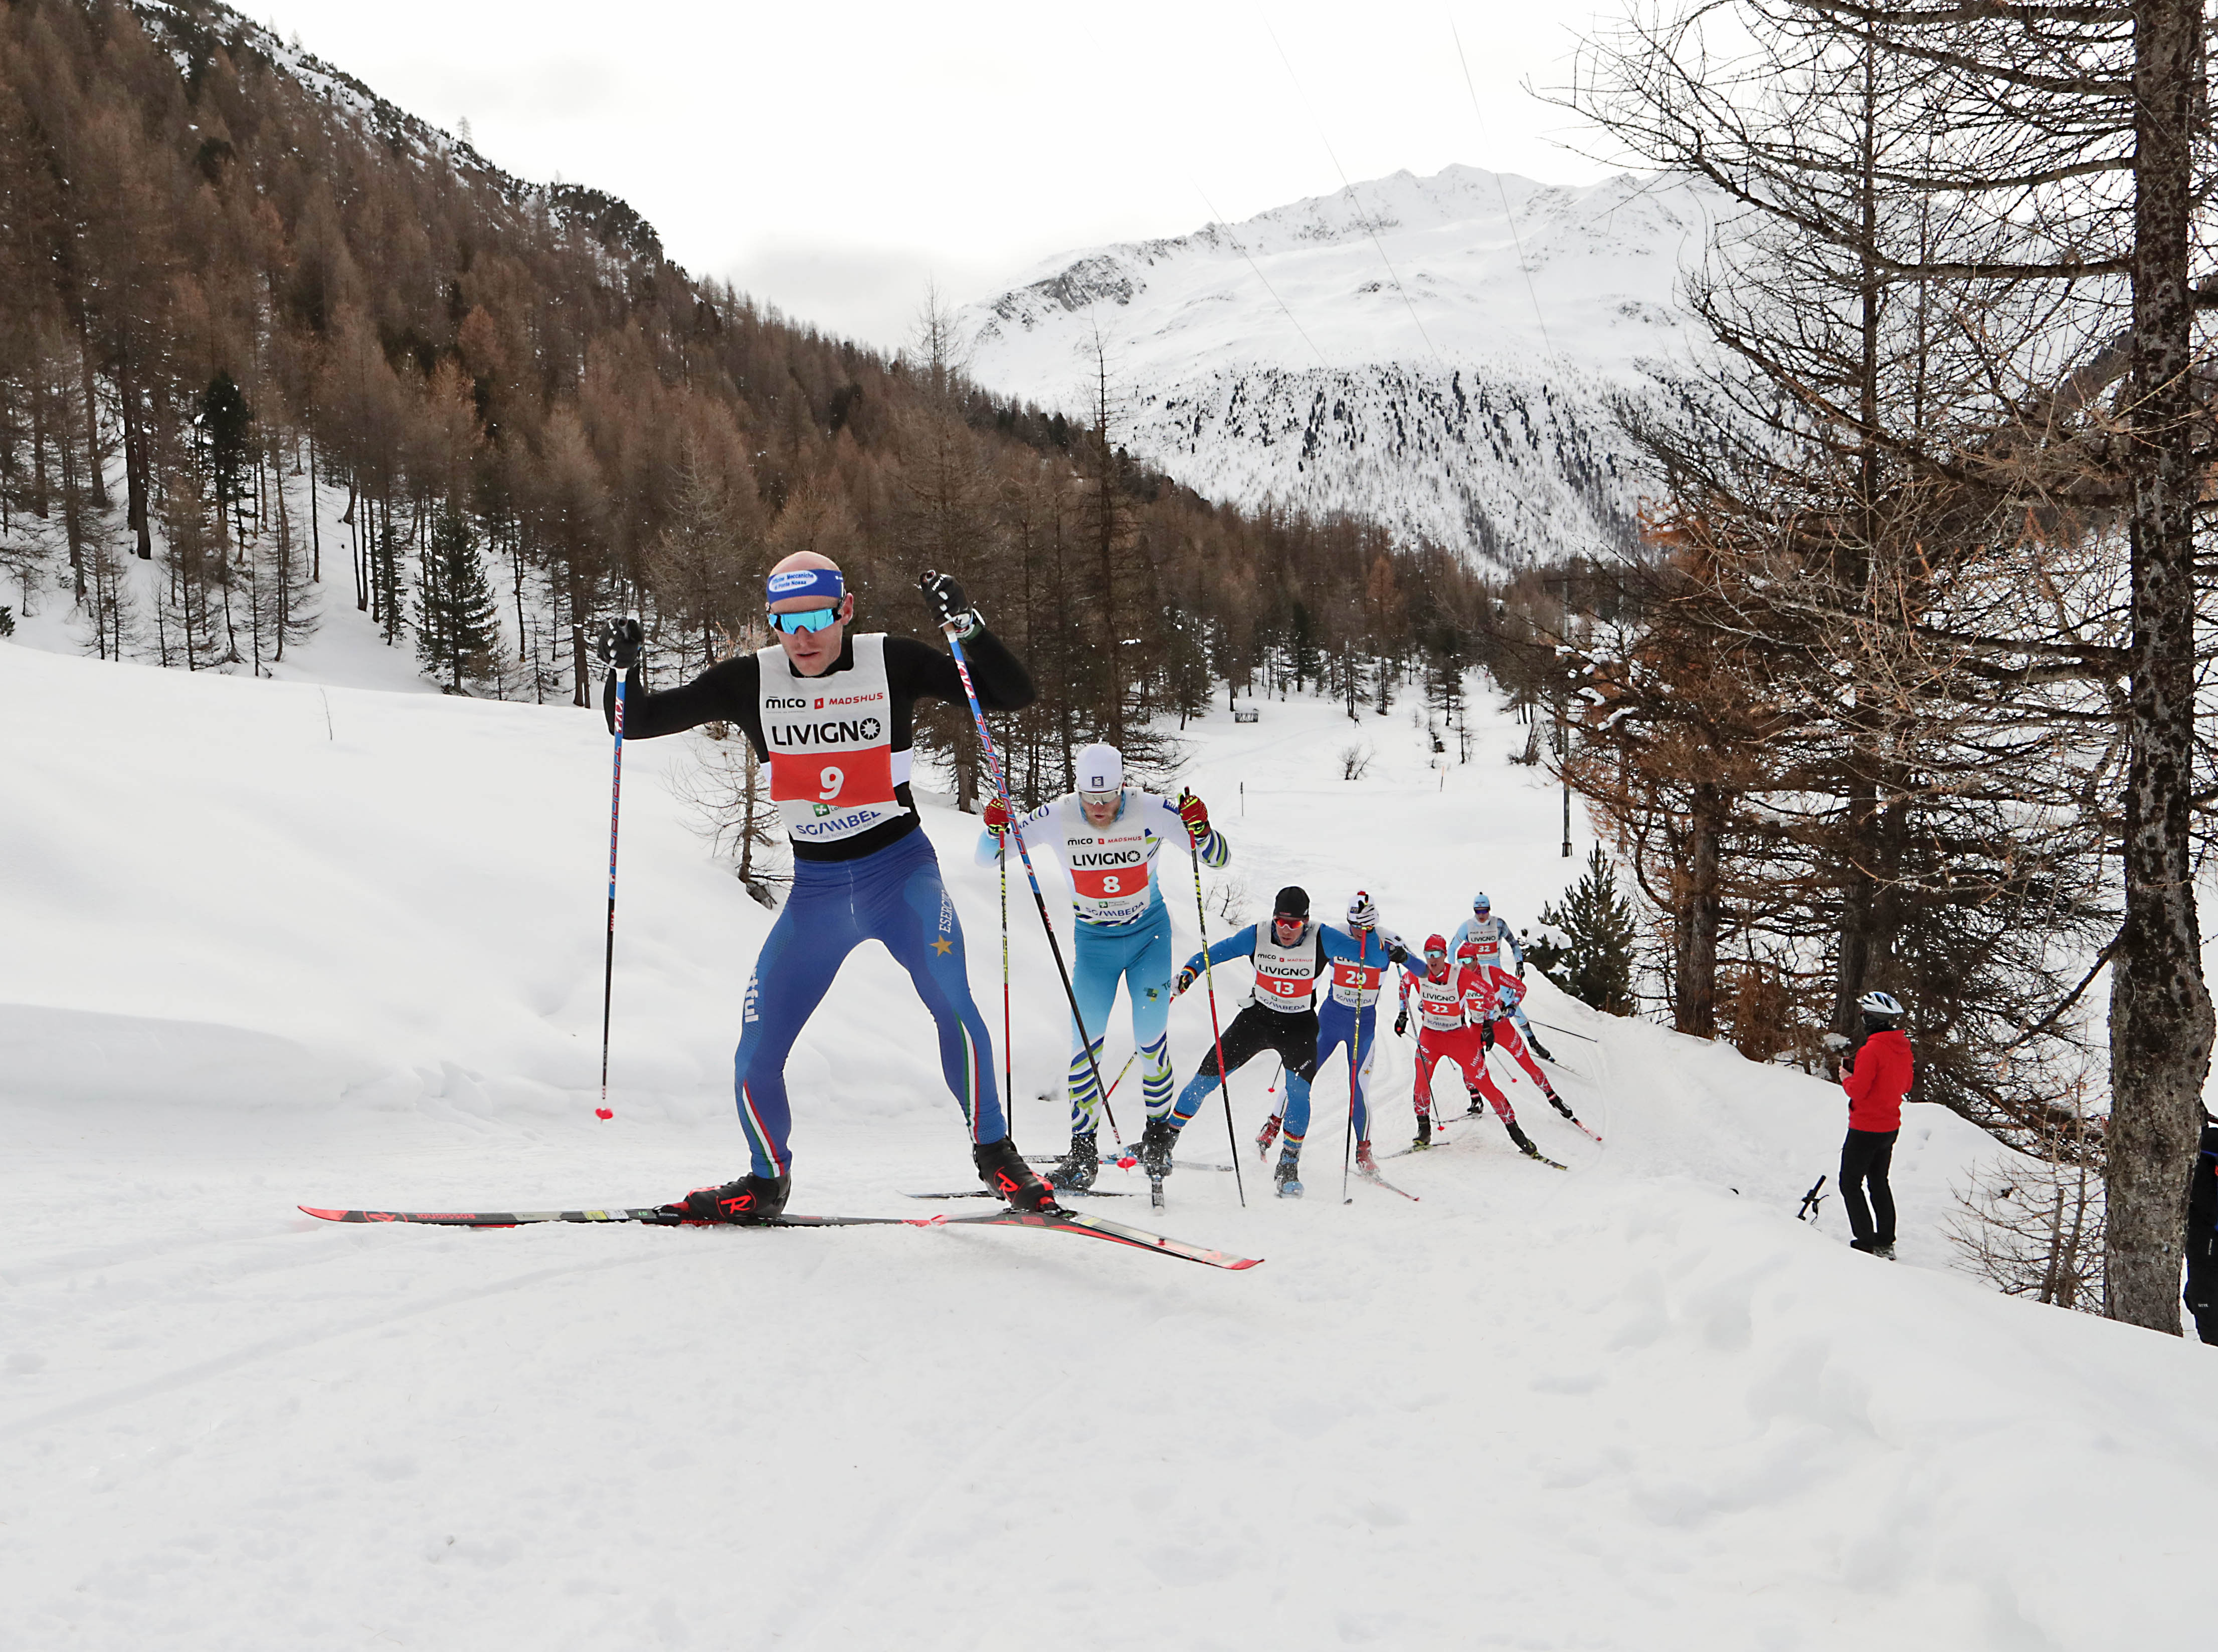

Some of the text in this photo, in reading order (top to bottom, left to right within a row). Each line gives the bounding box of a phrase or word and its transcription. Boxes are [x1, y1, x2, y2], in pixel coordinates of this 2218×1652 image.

[766, 692, 883, 709] mico MADSHUS
[772, 718, 881, 746] LIVIGNO
[819, 766, 844, 800] 9
[831, 830, 852, 839] NORDIC
[863, 819, 876, 830] RACE
[1067, 838, 1093, 846] mico
[1072, 850, 1141, 866] LIVIGNO
[1103, 876, 1121, 893] 8
[1259, 964, 1310, 976] LIVIGNO
[1345, 970, 1367, 985] 29
[1273, 980, 1295, 995] 13
[1423, 992, 1456, 1001] LIVIGNO
[1432, 1004, 1449, 1013] 22
